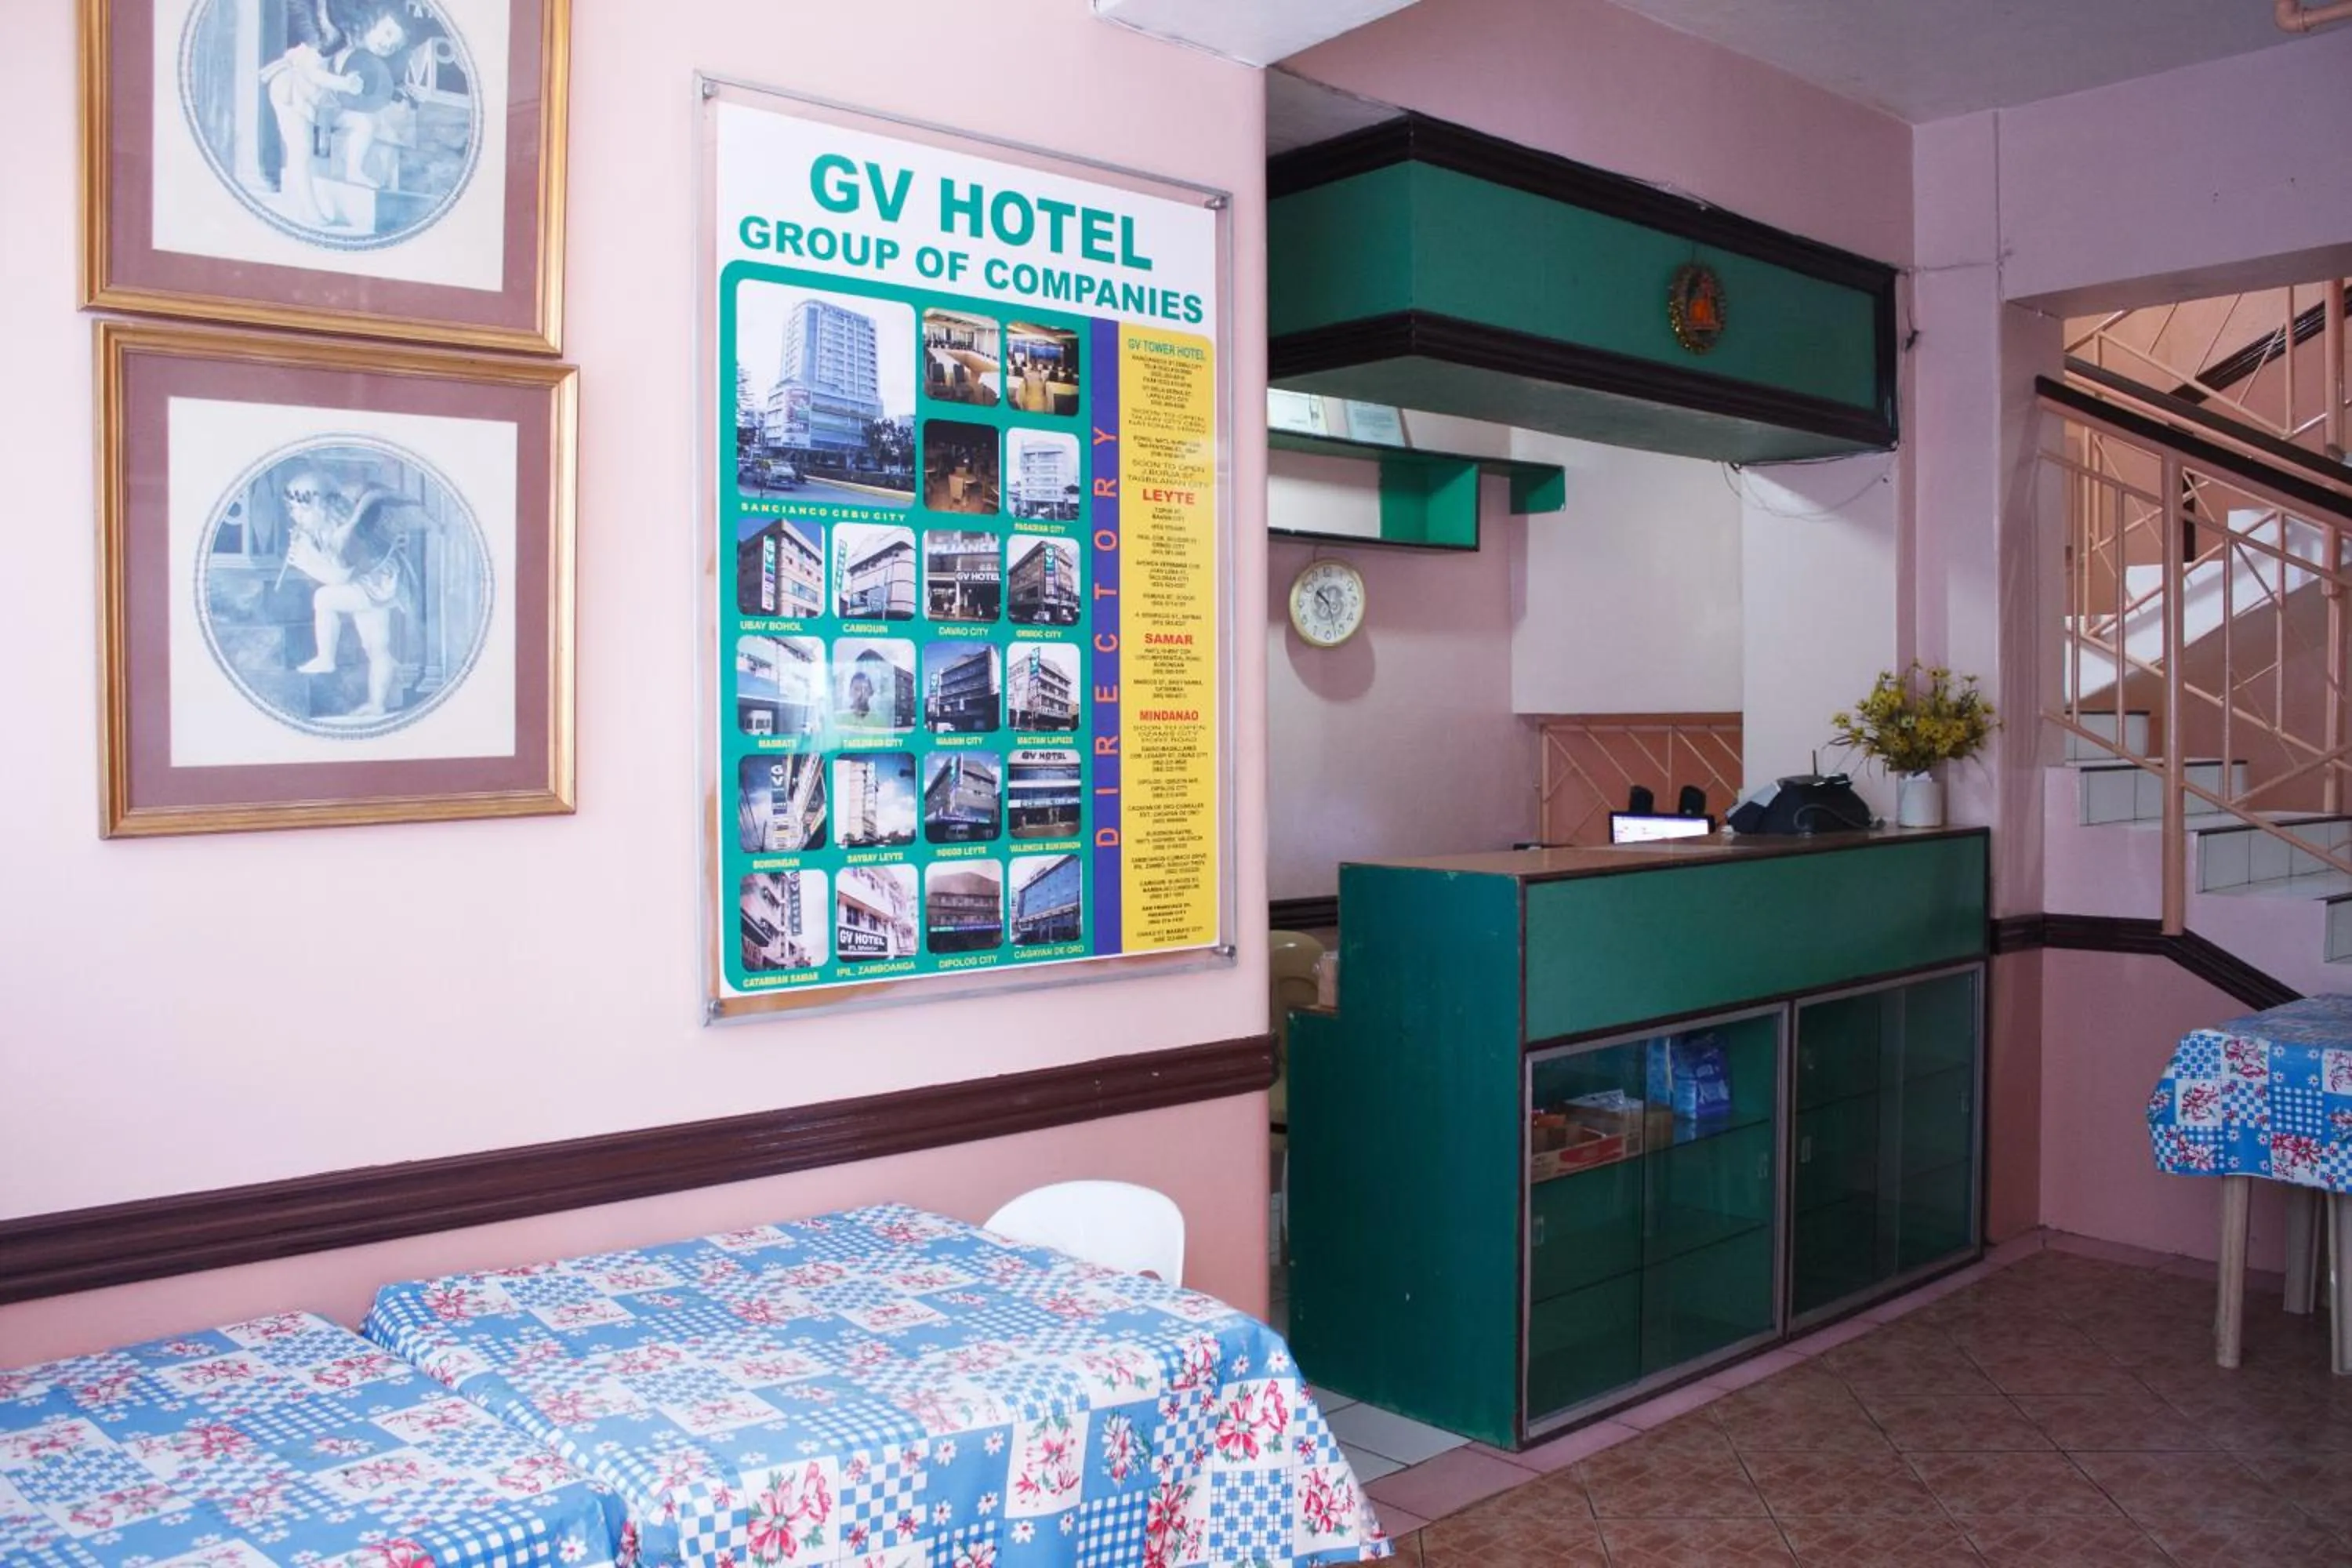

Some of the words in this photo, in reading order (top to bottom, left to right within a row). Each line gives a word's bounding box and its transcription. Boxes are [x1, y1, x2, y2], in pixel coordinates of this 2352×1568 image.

[810, 153, 914, 223] GV
[941, 176, 1152, 271] HOTEL
[739, 216, 900, 270] GROUP
[916, 246, 969, 281] OF
[984, 259, 1203, 323] COMPANIES
[1127, 338, 1141, 350] GV
[1143, 339, 1175, 355] TOWER
[1177, 345, 1206, 361] HOTEL
[1142, 488, 1195, 505] LEYTE
[832, 508, 869, 520] CEBU
[873, 511, 906, 522] CITY
[972, 572, 1001, 581] HOTEL
[740, 621, 766, 631] UBAY
[768, 622, 803, 633] BOHOL
[938, 626, 967, 636] DAVAO
[970, 628, 989, 637] CITY
[1094, 426, 1118, 848] DIRECTORY
[1144, 633, 1193, 645] SAMAR
[1139, 710, 1200, 721] MINDANAO
[1039, 752, 1067, 760] HOTEL
[771, 764, 784, 785] GV
[878, 852, 904, 862] LEYTE
[964, 846, 986, 855] LEYTE
[840, 929, 854, 944] GV
[855, 933, 884, 946] HOTEL
[979, 955, 998, 965] CITY
[1014, 949, 1053, 960] CAGAYAN
[1054, 948, 1065, 956] DE
[1066, 946, 1085, 954] ORO
[858, 961, 916, 976] ZAMBOANGA
